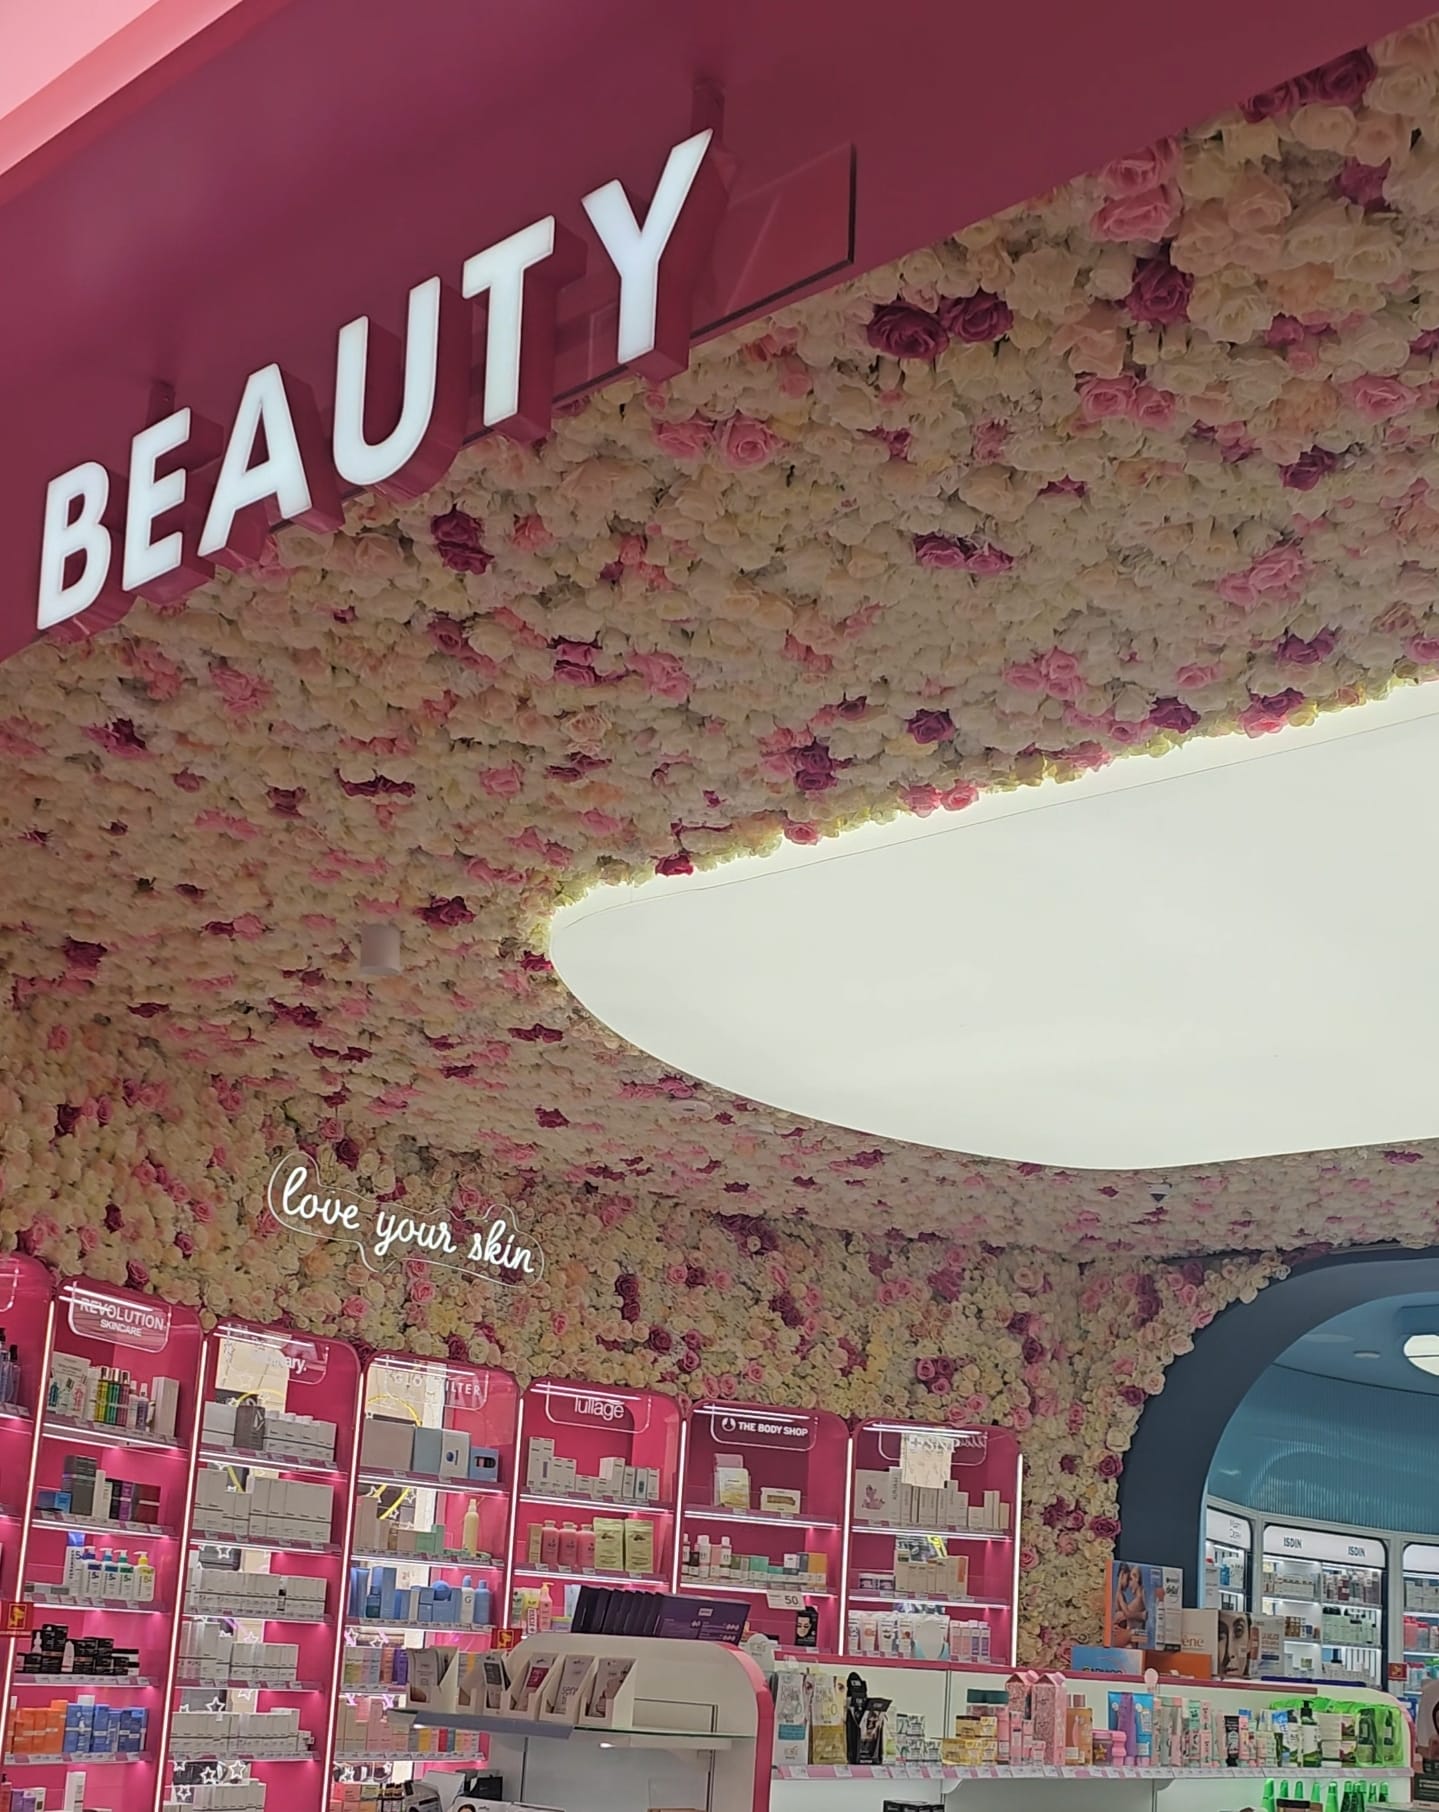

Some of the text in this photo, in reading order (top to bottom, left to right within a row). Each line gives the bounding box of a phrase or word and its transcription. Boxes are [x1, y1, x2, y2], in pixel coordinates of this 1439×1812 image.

[37, 128, 713, 631] BEAUTY
[282, 1166, 535, 1273] love your skin
[79, 1298, 165, 1331] REVOLUTION
[100, 1319, 142, 1337] SKINCARE
[445, 1380, 482, 1396] ILTER
[738, 1421, 809, 1437] THE BODY SHOP
[1283, 1536, 1303, 1549] ISDIN
[1348, 1546, 1366, 1558] ISDIN
[784, 1595, 799, 1606] 50
